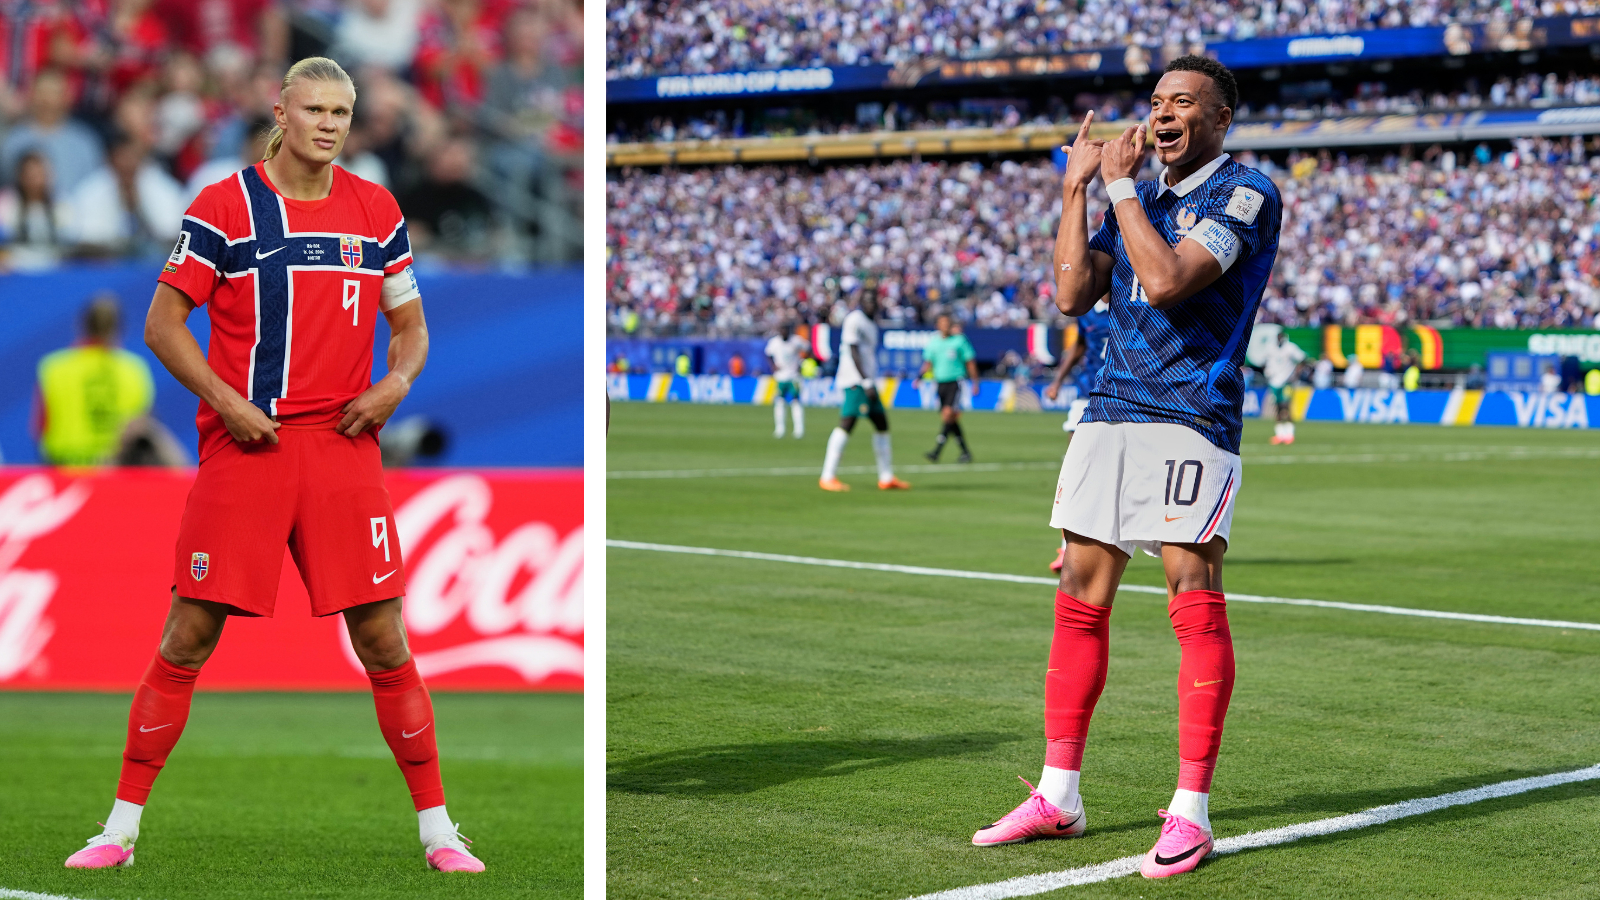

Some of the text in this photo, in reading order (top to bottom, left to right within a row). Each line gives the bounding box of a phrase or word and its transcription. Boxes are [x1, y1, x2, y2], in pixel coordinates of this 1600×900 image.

[1208, 224, 1234, 251] UNITES
[1213, 221, 1238, 245] FOOTBALL
[342, 279, 361, 327] 9
[1129, 273, 1149, 303] 1
[1337, 388, 1410, 423] VISA
[1508, 391, 1590, 429] VISA
[1164, 459, 1204, 506] 10
[369, 516, 391, 562] 9
